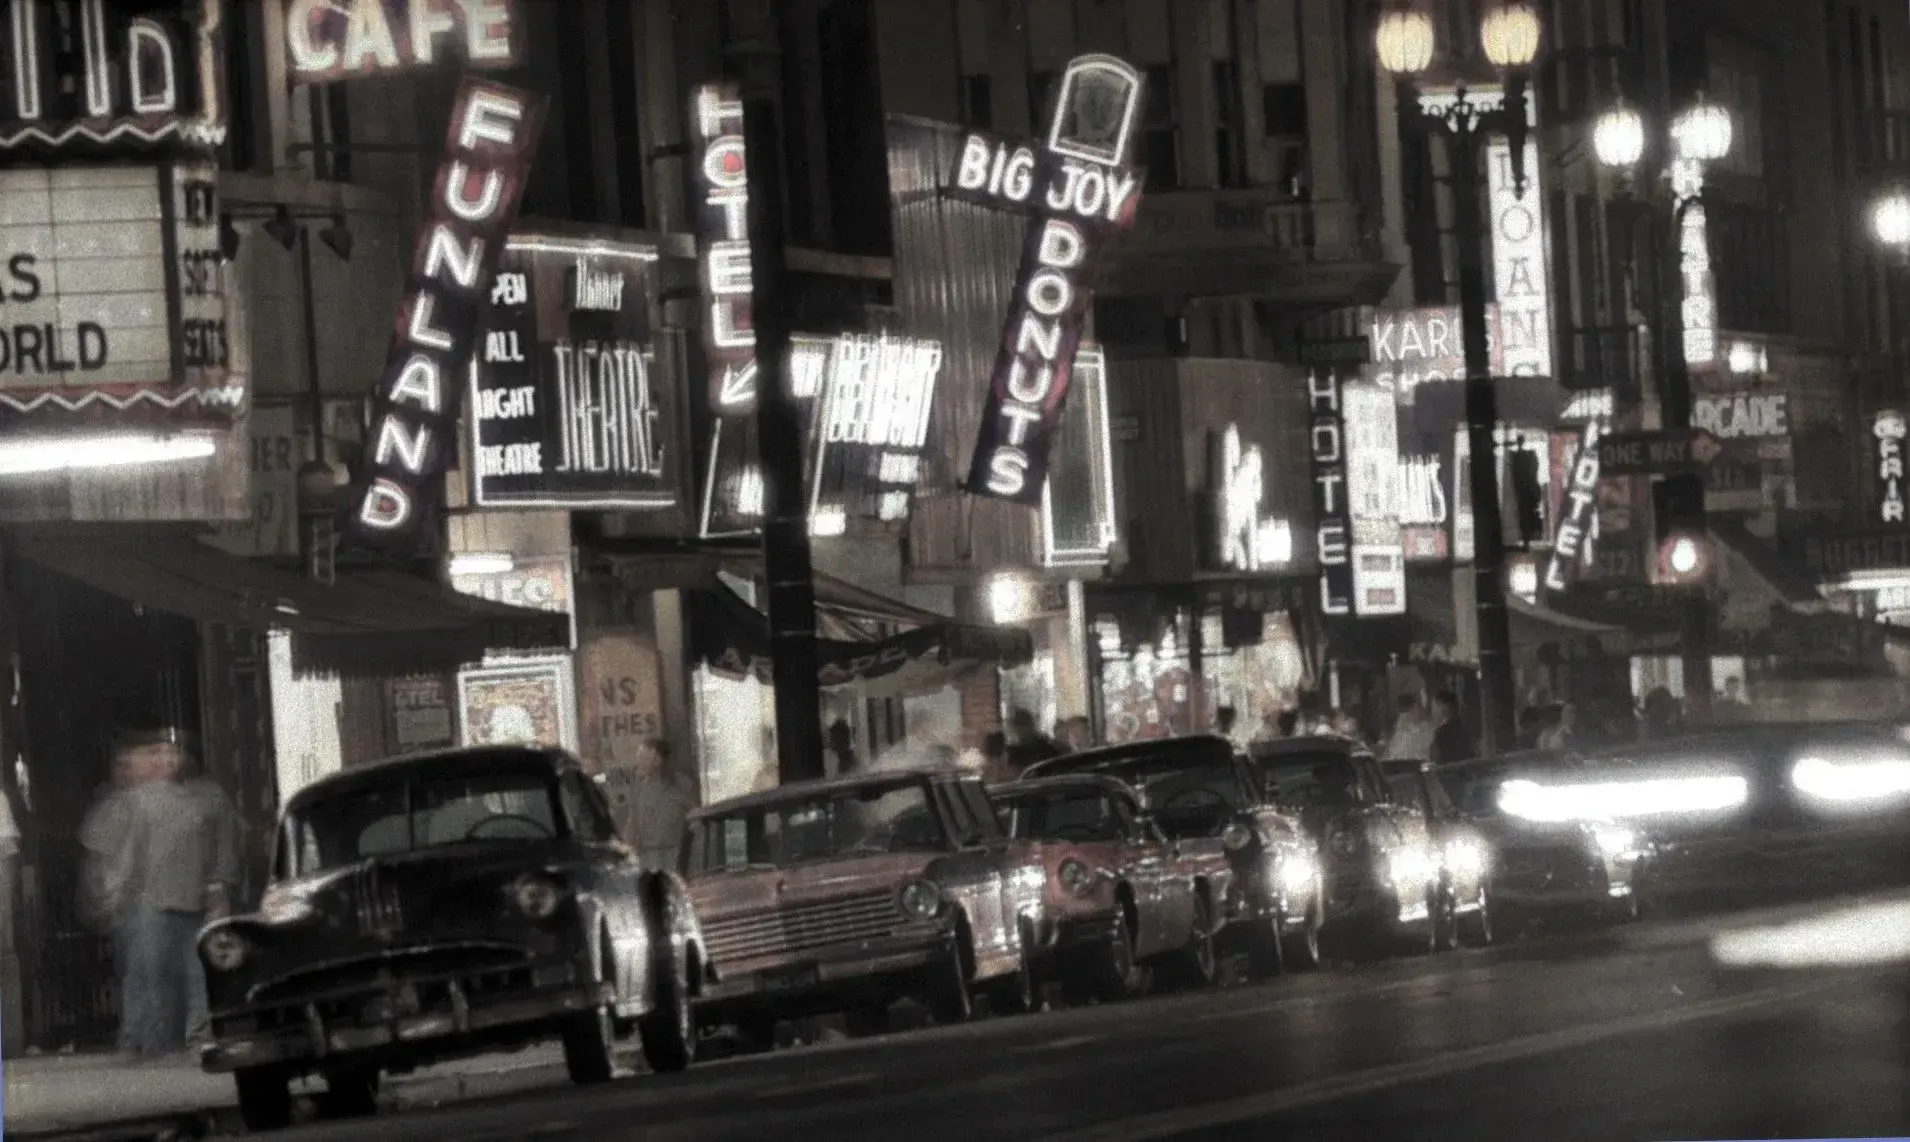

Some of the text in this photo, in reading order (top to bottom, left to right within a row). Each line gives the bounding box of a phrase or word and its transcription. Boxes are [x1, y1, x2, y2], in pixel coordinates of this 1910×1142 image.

[288, 0, 512, 72] CAFE
[957, 134, 1134, 220] BIG JOY
[358, 89, 525, 530] FUNLAND
[485, 329, 525, 362] ALL
[986, 218, 1086, 496] DONUTS
[552, 337, 664, 478] THEATRE
[1602, 437, 1687, 468] ONE WAY
[1307, 365, 1349, 615] HOTEL
